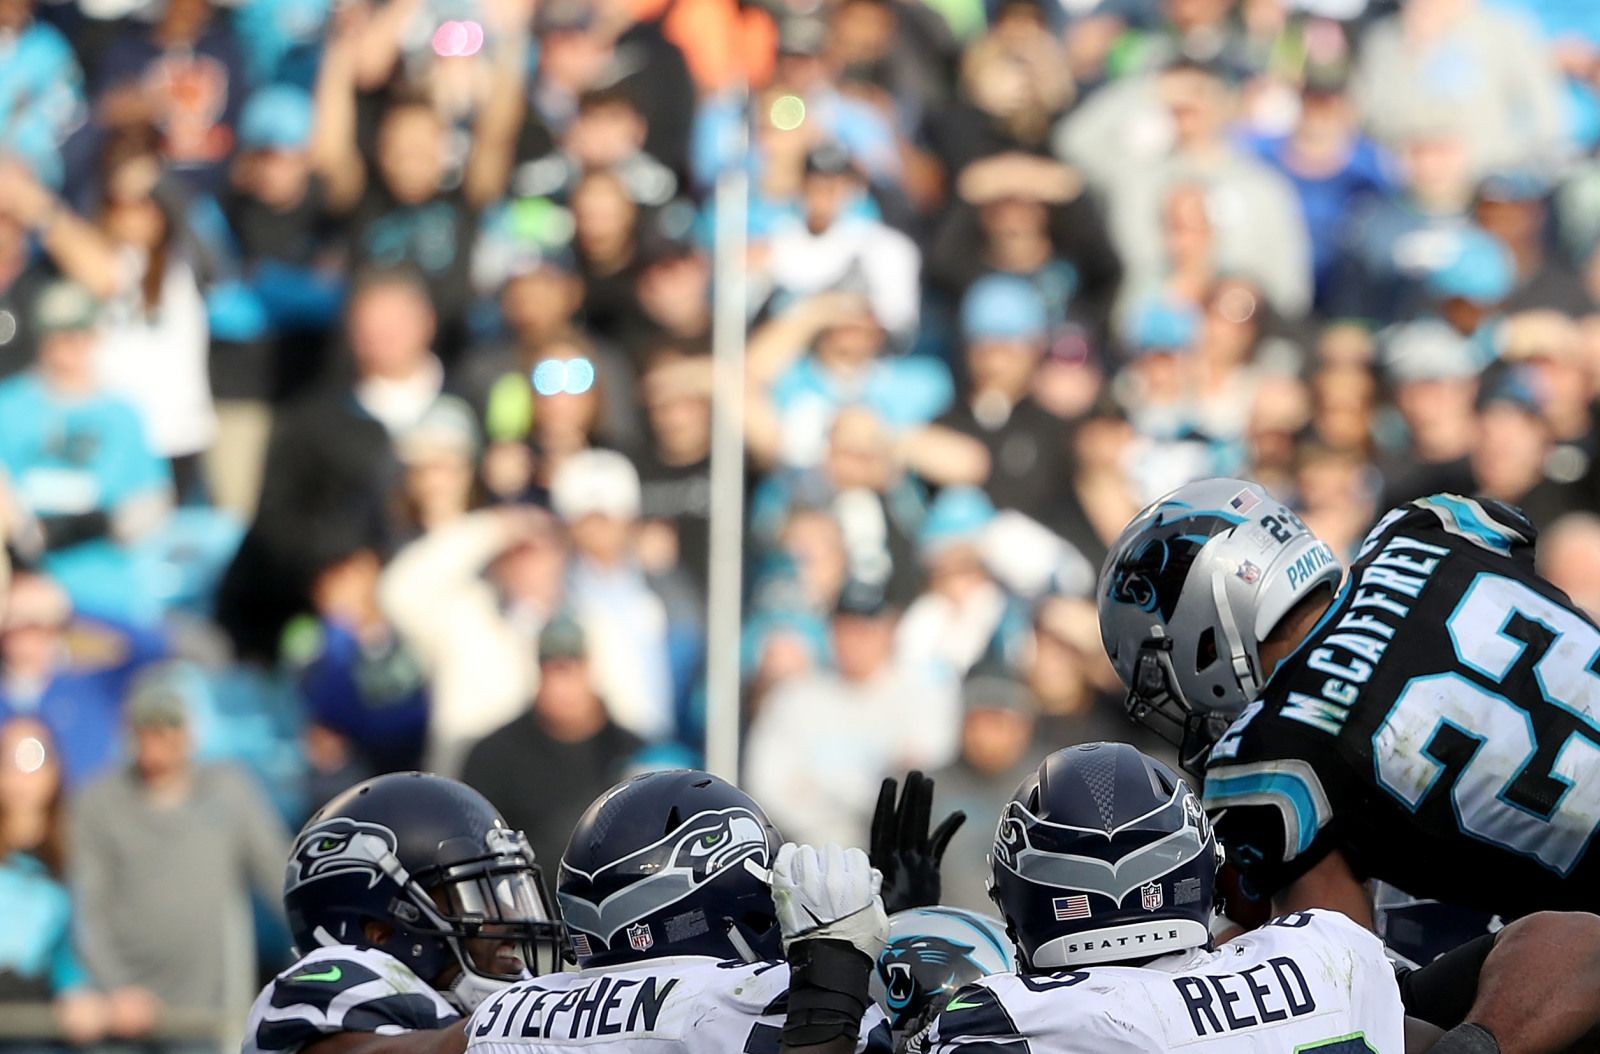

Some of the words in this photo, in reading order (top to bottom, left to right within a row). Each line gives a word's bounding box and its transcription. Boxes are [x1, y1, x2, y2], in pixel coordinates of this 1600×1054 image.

[1286, 544, 1334, 590] PANTH
[1279, 536, 1451, 736] McCAFFREY
[1069, 930, 1178, 953] SEATTLE
[475, 976, 680, 1039] STEPHEN
[1172, 957, 1316, 1036] REED
